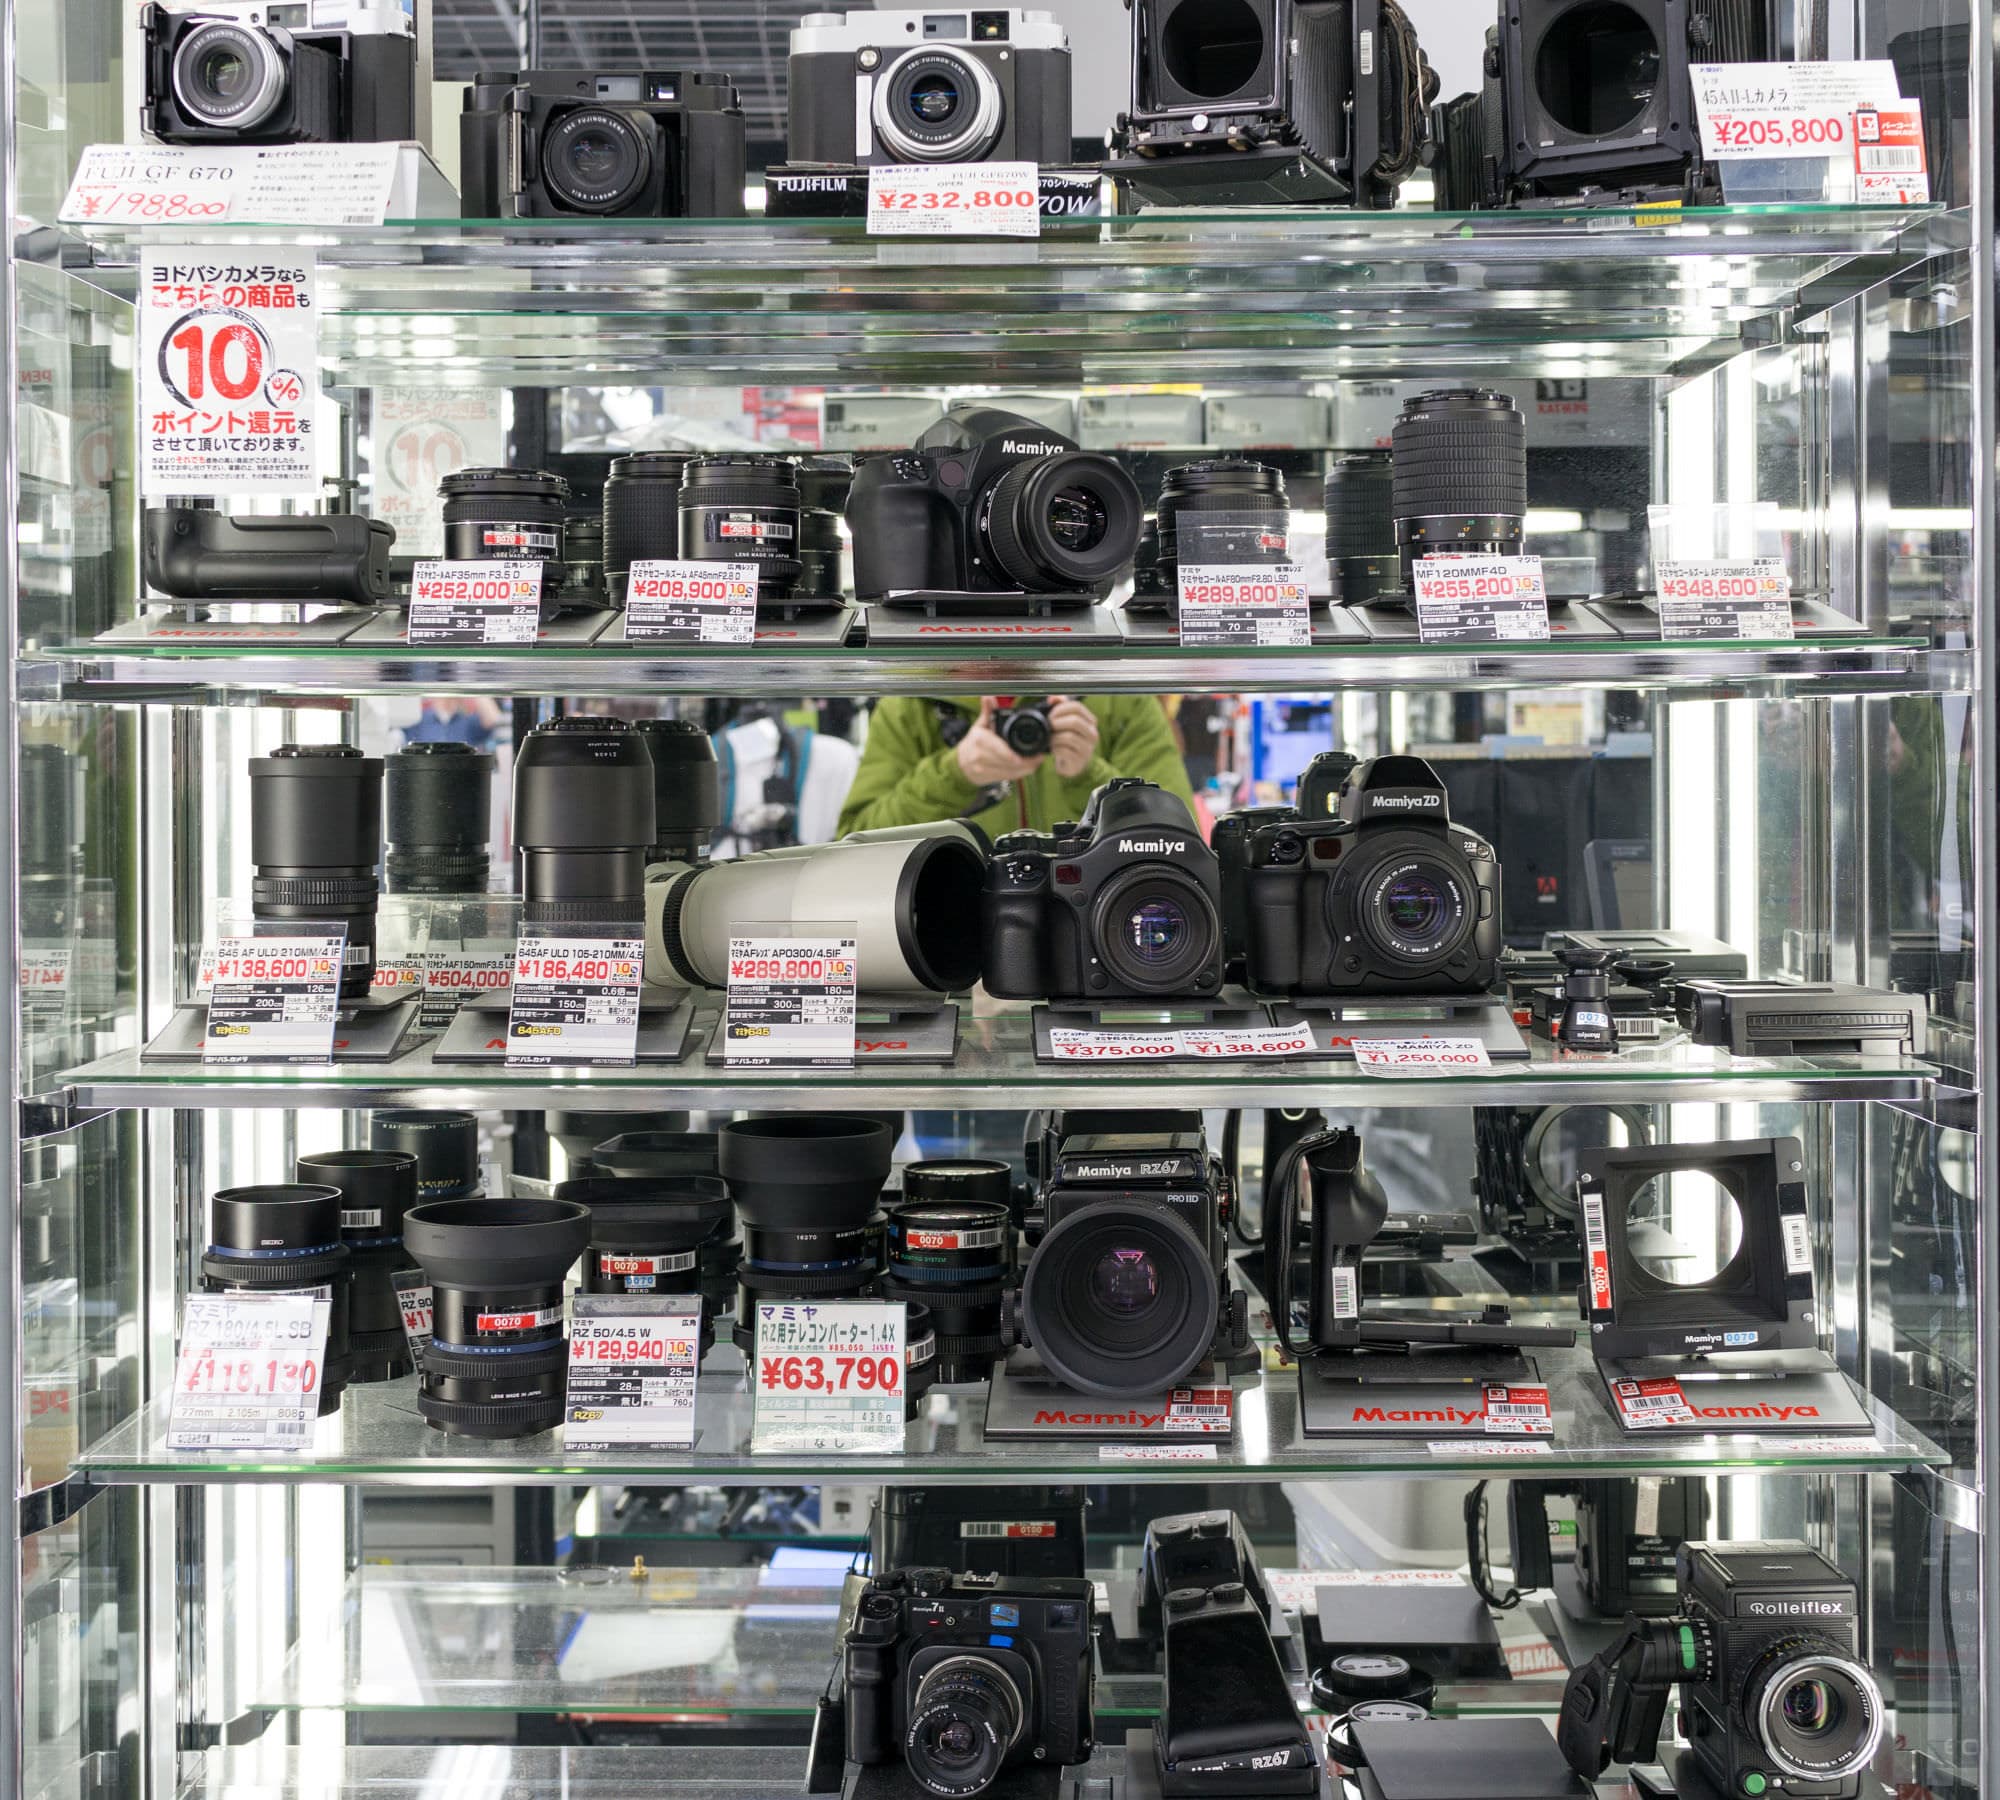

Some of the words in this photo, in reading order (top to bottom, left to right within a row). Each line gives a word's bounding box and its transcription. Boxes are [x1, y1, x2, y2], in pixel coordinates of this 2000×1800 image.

[1715, 116, 1844, 147] ¥205,800
[84, 165, 134, 181] FUJI
[145, 165, 180, 180] GF
[188, 166, 233, 181] 670
[777, 177, 848, 193] FUJIFILM
[878, 190, 1035, 211] ¥232,800
[152, 265, 306, 282] ヨドバシカメラなら
[152, 284, 311, 309] こちらの商品も
[151, 410, 311, 434] ポイント還元を
[151, 437, 306, 452] させて頂いております。
[1002, 439, 1064, 454] Mamiya
[418, 581, 511, 603] ¥252,000
[634, 580, 727, 601] ¥208,900
[1421, 576, 1514, 600] ¥255,200
[1662, 578, 1757, 600] ¥348,600
[1184, 585, 1278, 607] ¥289,800
[456, 620, 469, 628] 35
[672, 617, 686, 626] 45
[1227, 623, 1241, 631] 70
[1466, 617, 1480, 626] 40
[1703, 616, 1722, 625] 100
[918, 624, 1073, 633] Mamiya
[1118, 839, 1186, 855] Mamiya
[218, 948, 238, 958] 645
[242, 948, 256, 957] AF
[257, 948, 278, 958] ULD
[330, 948, 340, 956] IF
[518, 949, 549, 959] 645AF
[550, 949, 569, 958] ULD
[572, 949, 643, 960] 105-210MM/4.5
[772, 948, 841, 958] APO300/4.5IF
[217, 959, 307, 981] ¥138,600
[518, 960, 609, 981] ¥186,480
[731, 960, 823, 982] ¥289,800
[428, 970, 510, 988] ¥504,000
[306, 984, 335, 993] 126mm
[823, 986, 853, 995] 180mm
[255, 998, 283, 1008] 200cm
[773, 1000, 801, 1009] 300cm
[564, 1013, 584, 1024] 無し
[1064, 1045, 1175, 1056] ¥375,000
[1198, 1040, 1306, 1054] ¥138,600
[1368, 1053, 1479, 1064] ¥1,250,000
[1077, 1164, 1132, 1178] Mamiya
[1140, 1160, 1180, 1175] RZ67
[1167, 1194, 1184, 1203] PRO
[919, 1235, 944, 1245] 0070
[614, 1261, 638, 1271] 0070
[1597, 1266, 1606, 1292] 0070
[190, 1303, 238, 1318] マミヤ
[402, 1301, 416, 1310] RZ
[760, 1306, 818, 1321] マミヤ
[288, 1320, 312, 1338] SB
[494, 1317, 521, 1326] 0070
[682, 1319, 697, 1327] 広角
[572, 1328, 591, 1338] RZ
[593, 1328, 637, 1338] 50/4.5
[639, 1328, 651, 1337] W
[761, 1322, 896, 1343] RZ用テレコンバーター1.4X
[1684, 1334, 1722, 1343] Mamiya
[1726, 1332, 1756, 1342] 0070
[572, 1340, 664, 1362] ¥129,940
[187, 1359, 317, 1396] ¥118,130
[669, 1368, 692, 1376] 25mm
[761, 1356, 899, 1395] ¥63,790
[619, 1382, 641, 1391] 28cm
[1750, 1600, 1843, 1615] Rolleiflex
[1252, 1750, 1290, 1770] RZ67
